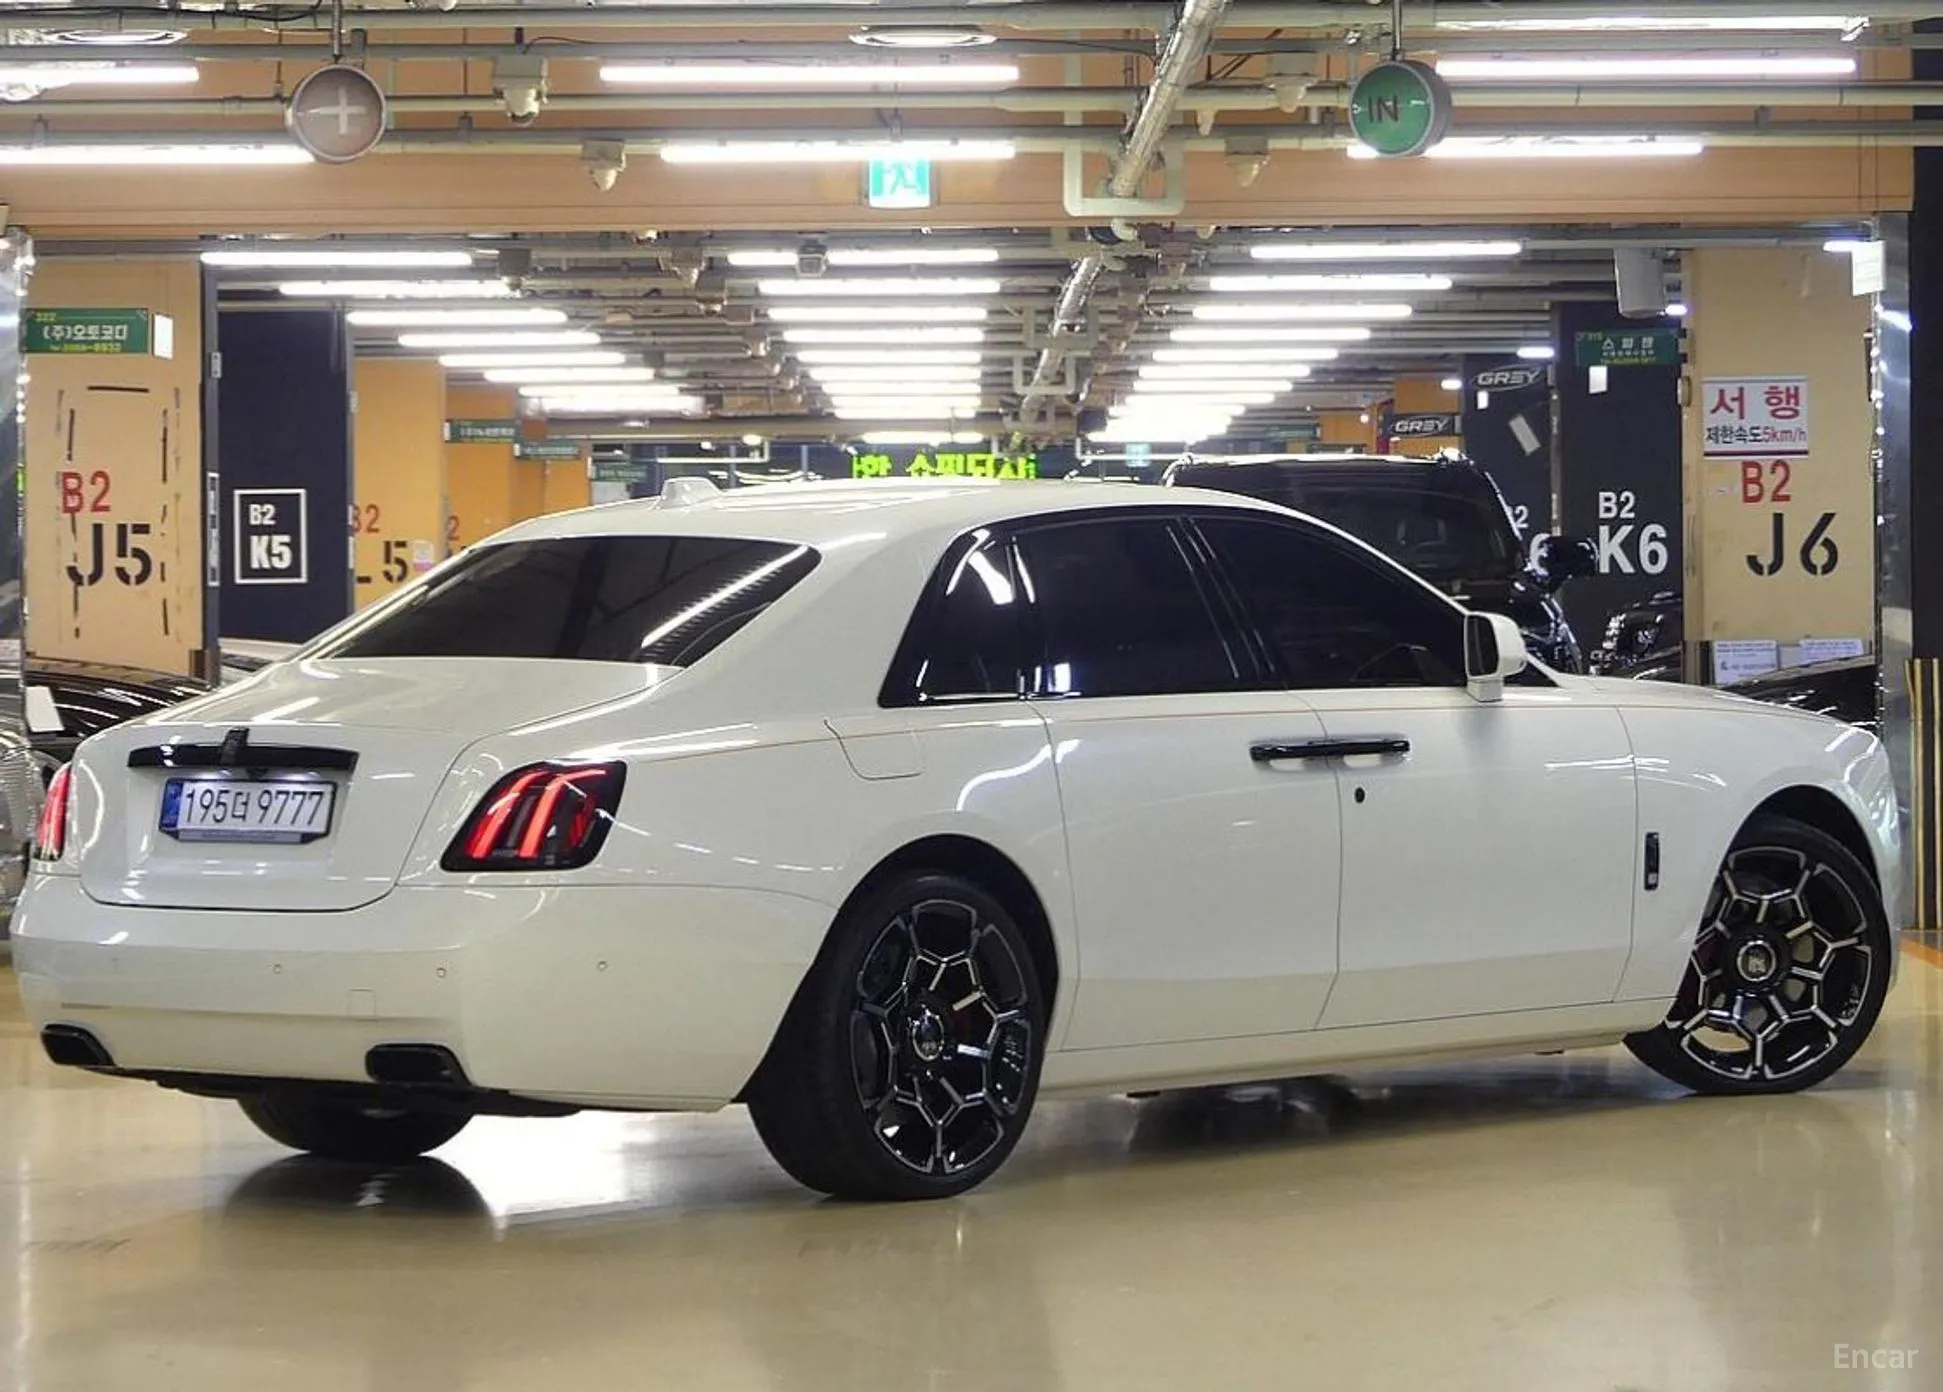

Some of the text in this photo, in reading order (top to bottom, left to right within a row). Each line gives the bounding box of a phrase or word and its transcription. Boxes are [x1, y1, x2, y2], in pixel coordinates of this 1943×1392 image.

[1368, 95, 1399, 123] IN
[62, 471, 111, 513] B2
[1742, 459, 1791, 504] B2
[249, 503, 276, 526] B2
[1599, 491, 1635, 519] B2
[66, 522, 153, 587] J5
[250, 534, 293, 570] K5
[1599, 524, 1668, 574] K6
[1746, 512, 1839, 577] J6
[186, 788, 251, 824] 195더
[257, 789, 325, 826] 9777
